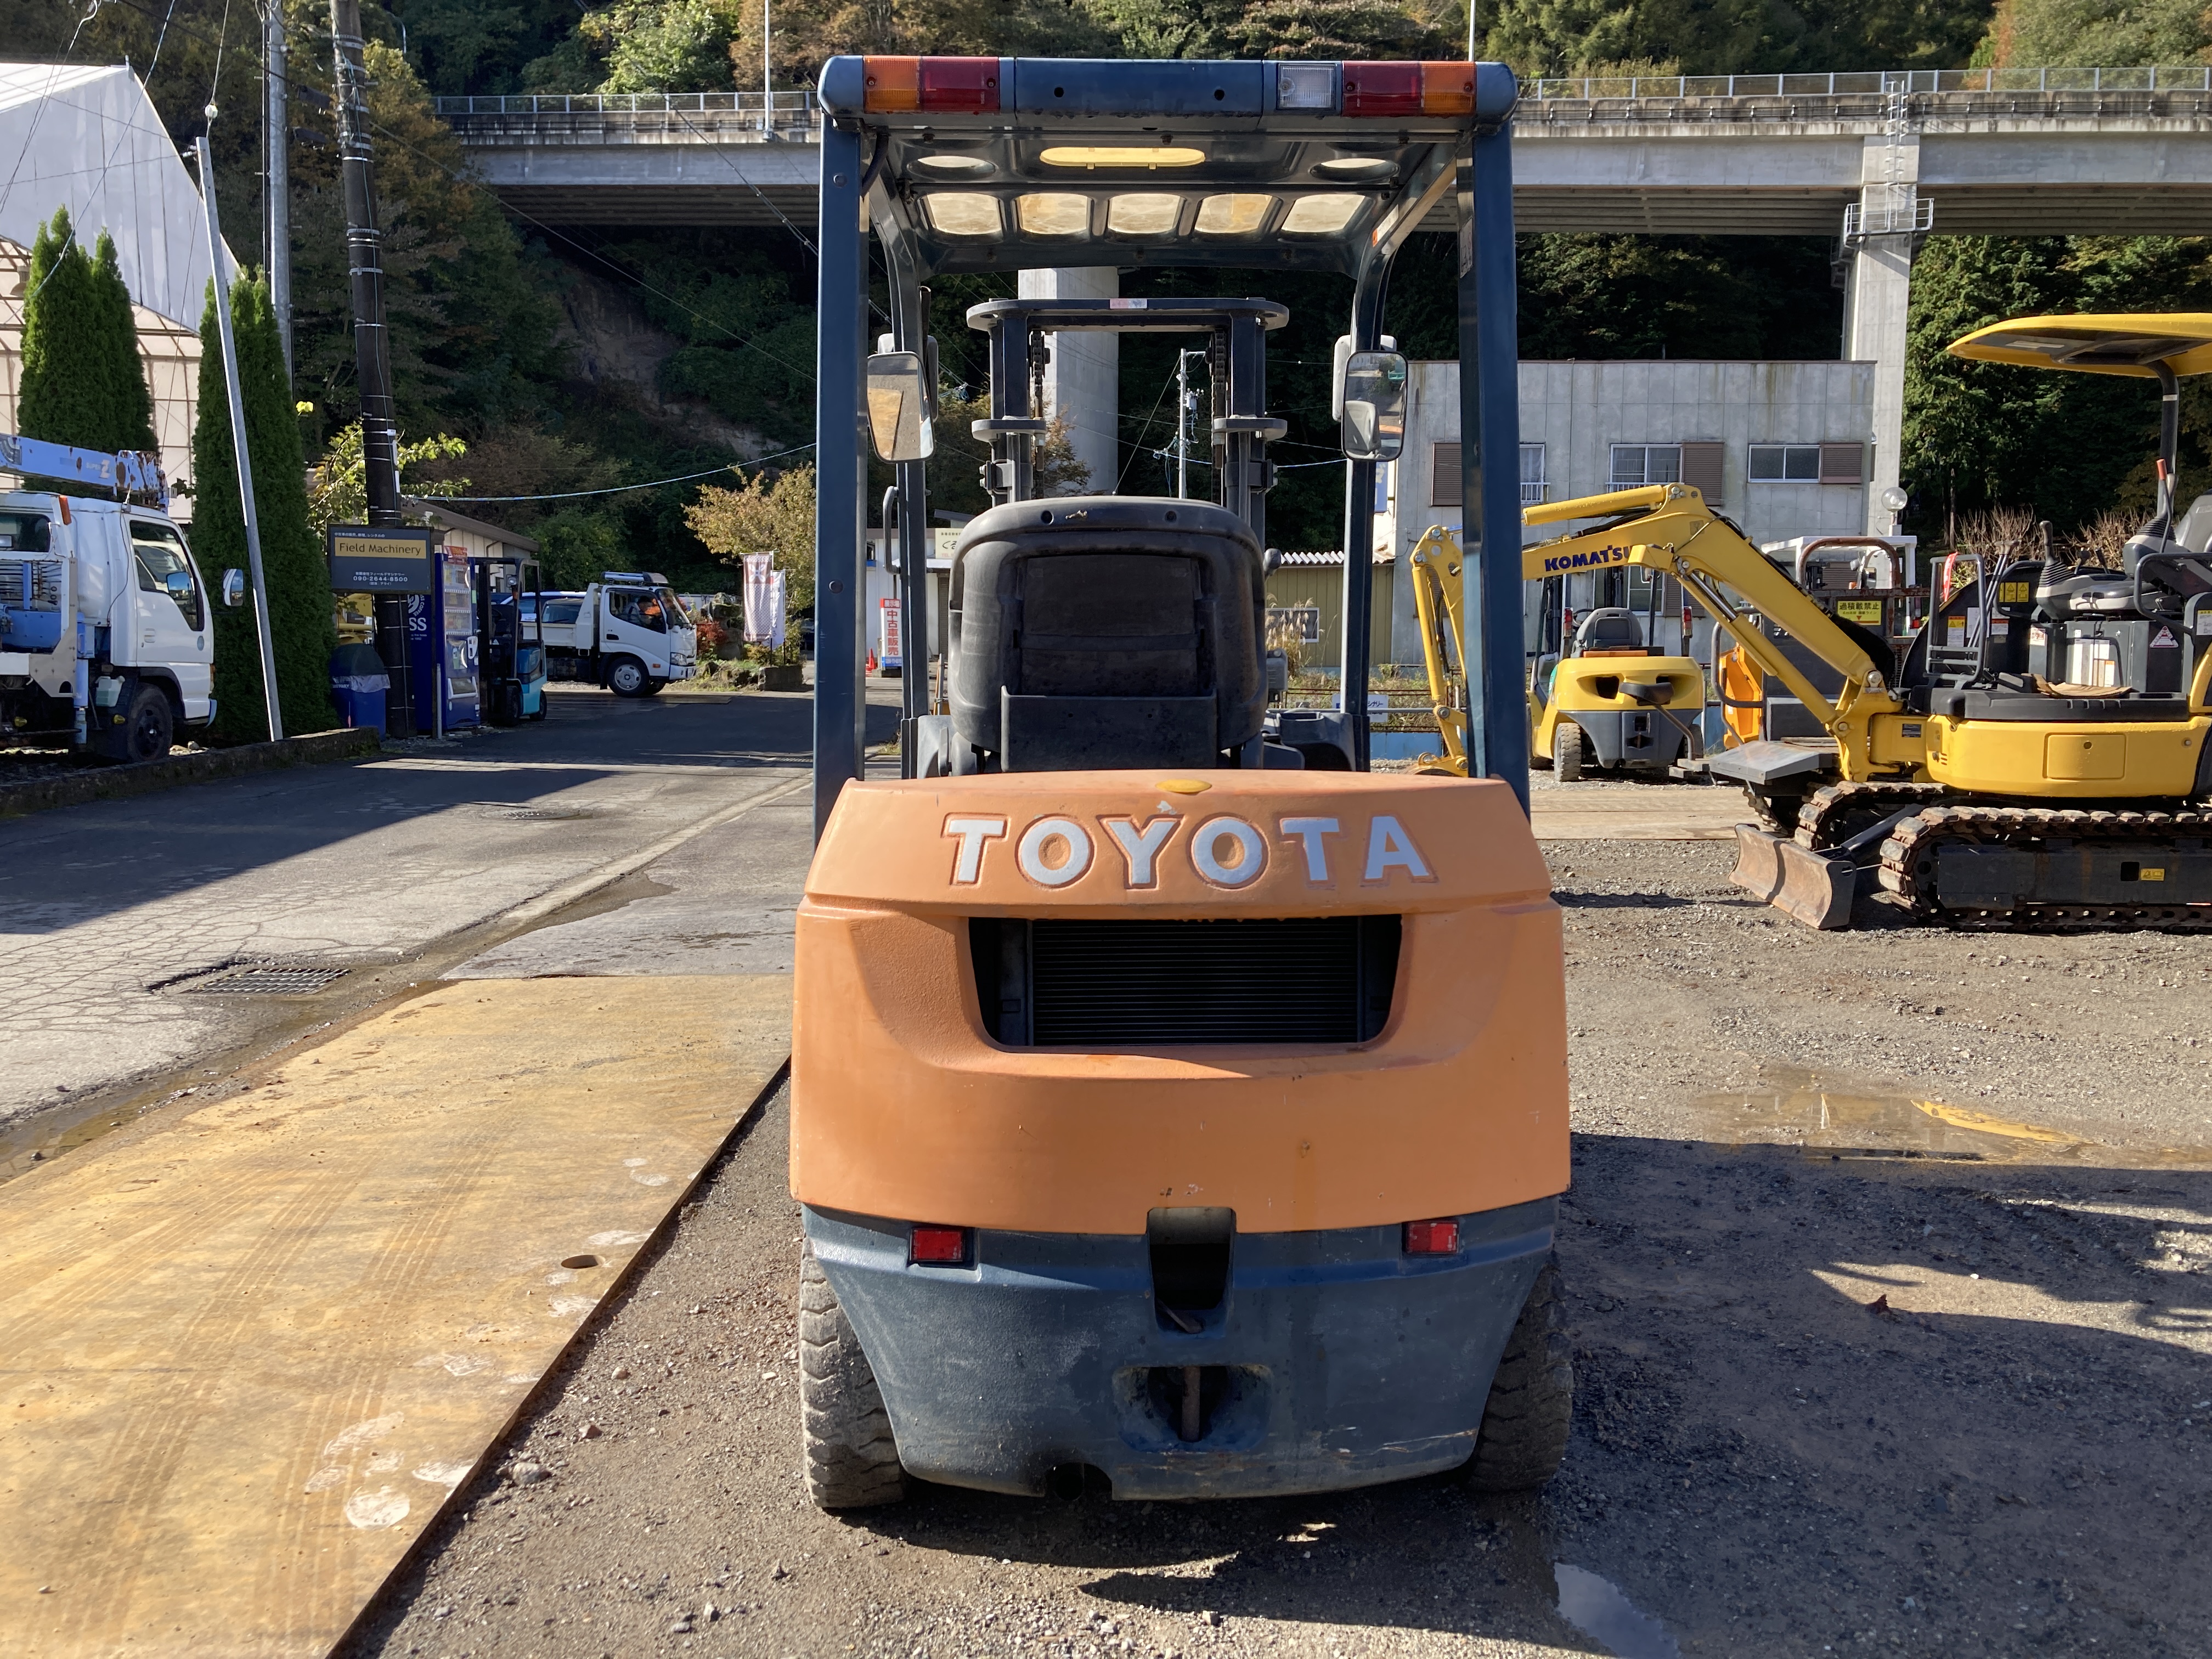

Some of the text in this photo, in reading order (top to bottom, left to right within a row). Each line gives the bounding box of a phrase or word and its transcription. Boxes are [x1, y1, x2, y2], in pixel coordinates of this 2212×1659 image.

[340, 543, 421, 556] Field Machinery
[413, 602, 425, 617] COFFEE
[409, 617, 427, 631] SS
[887, 610, 899, 656] 中古車販売
[943, 813, 1434, 888] TOYOTA
